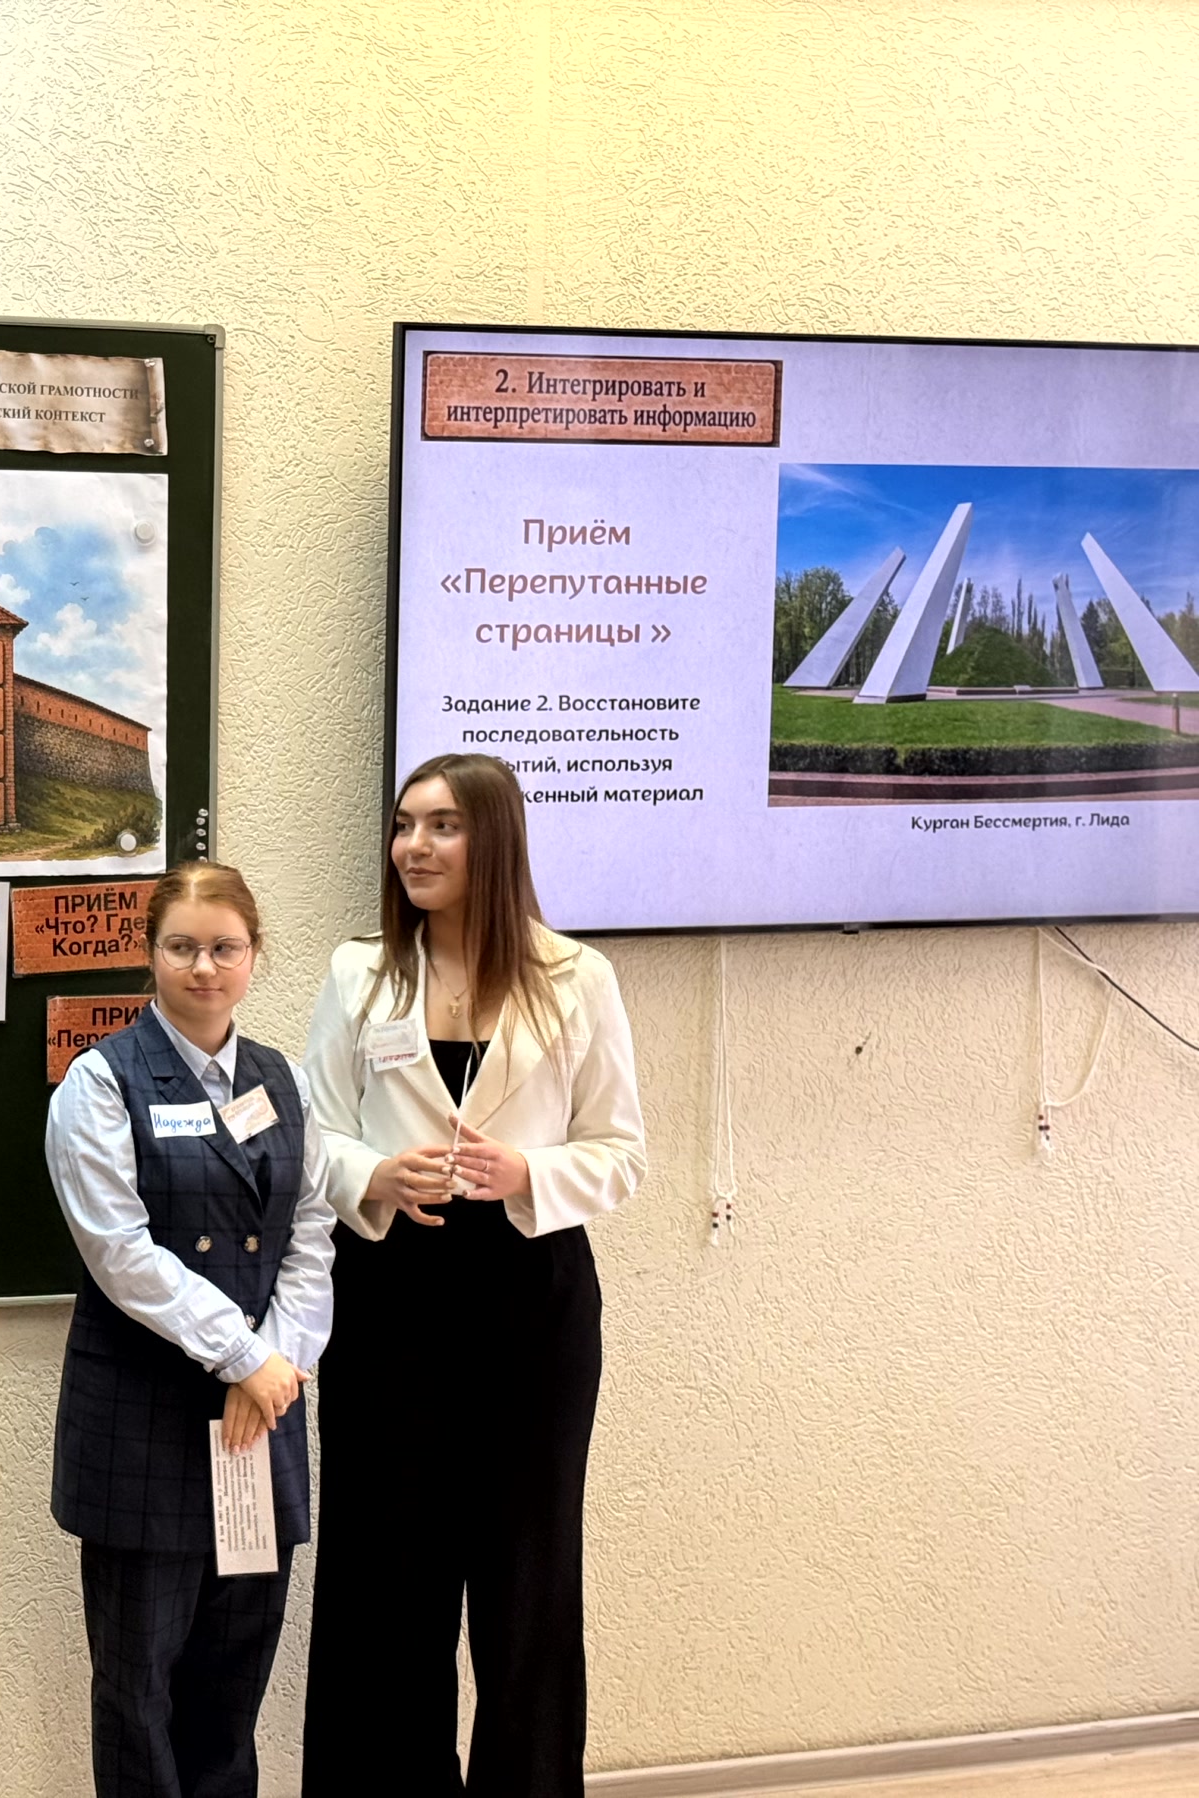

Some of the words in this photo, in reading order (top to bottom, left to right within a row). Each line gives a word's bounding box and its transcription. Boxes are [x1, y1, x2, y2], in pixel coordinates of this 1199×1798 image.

[40, 384, 139, 400] ГРАМОТНОСТИ
[495, 369, 517, 393] 2.
[527, 371, 686, 401] Интегрировать
[693, 382, 706, 397] и
[35, 409, 106, 423] КОНТЕКСТ
[447, 404, 627, 428] интерпретировать
[634, 404, 756, 432] информацию
[523, 519, 631, 552] Приём
[441, 568, 708, 602] «Перепутанные
[476, 623, 641, 651] страницы
[442, 695, 531, 714] Задание
[536, 695, 553, 711] 2.
[559, 695, 701, 712] Восстановите
[462, 726, 679, 745] последовательность
[506, 756, 562, 775] ытий,
[566, 757, 672, 775] используя
[604, 788, 704, 806] материал
[911, 815, 970, 833] Курган
[973, 814, 1071, 831] Бессмертия,
[1075, 816, 1086, 827] г.
[1089, 813, 1130, 828] Лида
[54, 889, 138, 914] ПРИЁМ
[35, 914, 98, 936] «Что?
[106, 915, 146, 934] Где
[92, 1007, 144, 1026] ПРИ
[153, 1112, 211, 1134] Надежда
